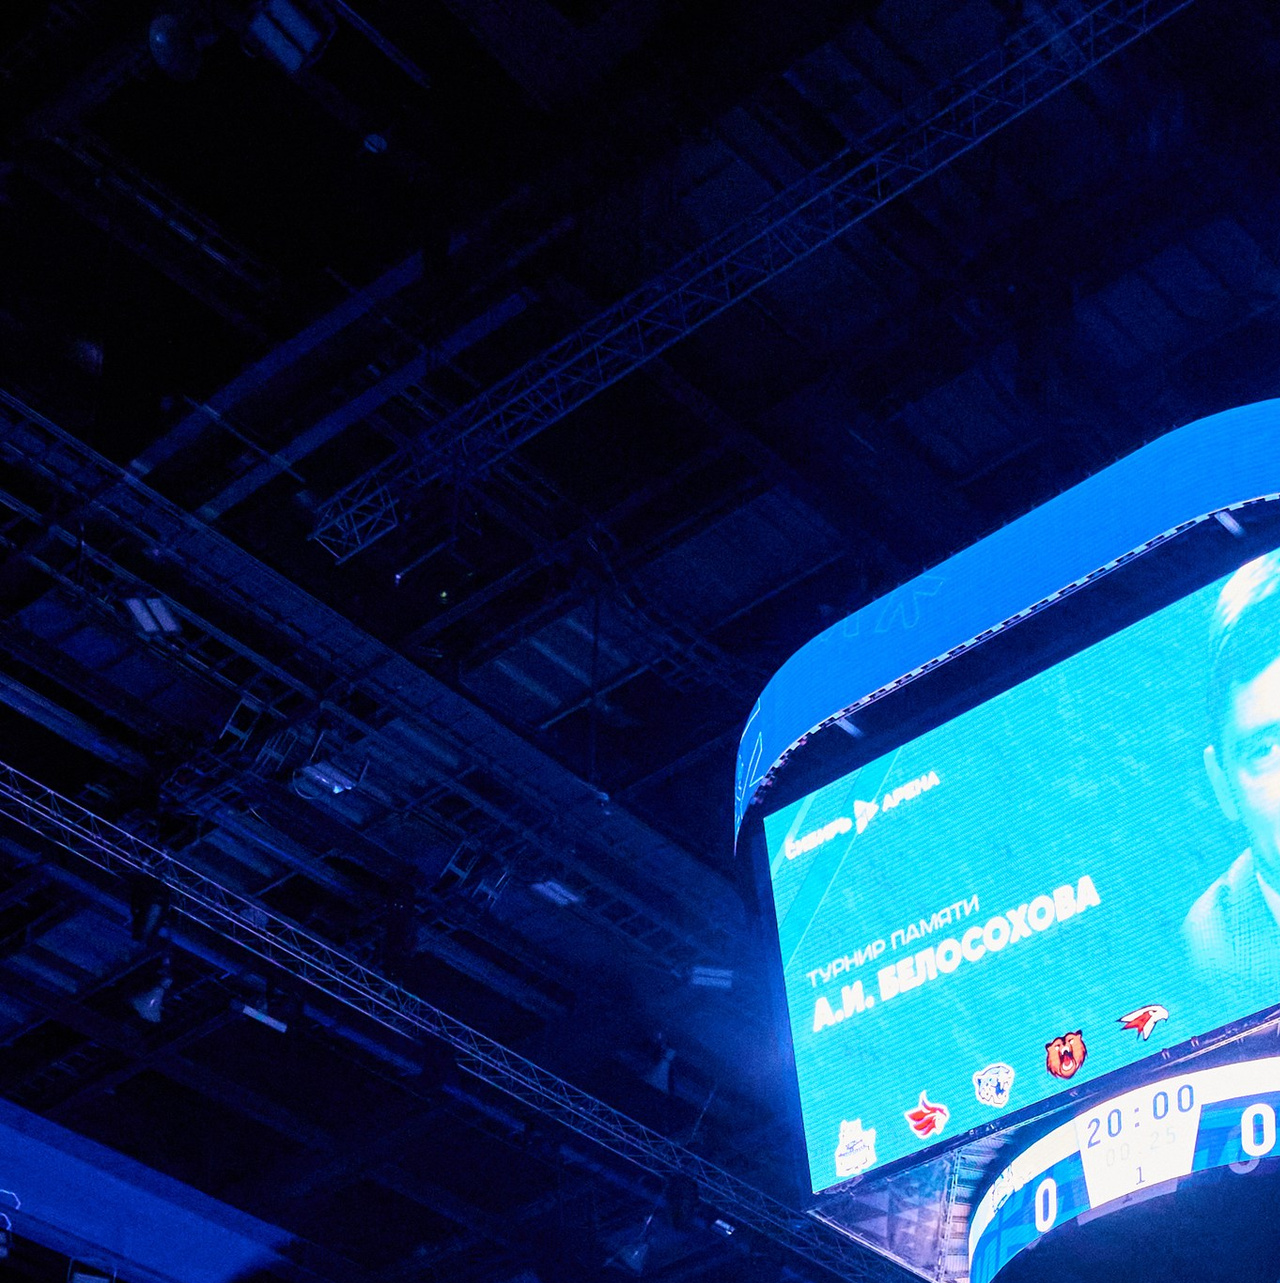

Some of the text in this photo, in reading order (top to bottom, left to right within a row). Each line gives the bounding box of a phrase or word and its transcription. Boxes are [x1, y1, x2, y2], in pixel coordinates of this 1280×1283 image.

[805, 894, 980, 987] ТУРНИР ПАМЯТИ
[812, 874, 1101, 1032] А.И. БЕЛОСОХОВА
[1086, 1084, 1195, 1149] 20:00
[1241, 1103, 1276, 1156] 0
[1035, 1178, 1057, 1232] 0
[1135, 1166, 1146, 1185] 1
